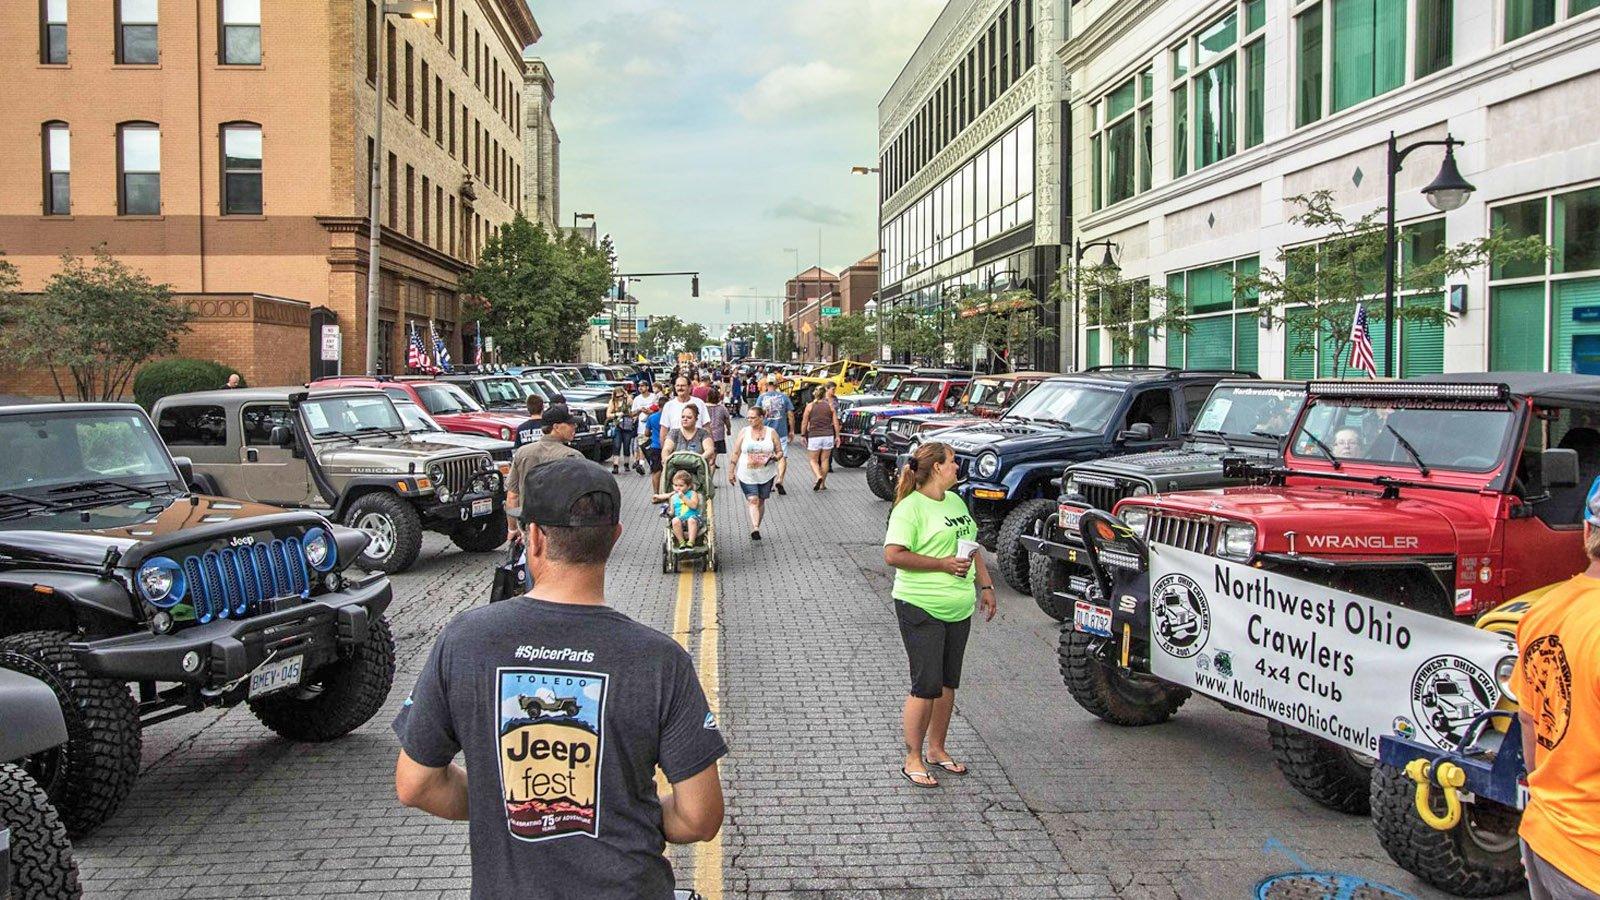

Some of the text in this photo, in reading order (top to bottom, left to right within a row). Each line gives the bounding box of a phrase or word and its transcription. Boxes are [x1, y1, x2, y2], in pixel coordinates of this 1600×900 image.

[230, 536, 254, 547] Jeep
[955, 526, 970, 539] girl
[1305, 535, 1419, 549] WRANGLER
[1214, 564, 1411, 649] Northwest Ohio
[515, 645, 595, 662] #SpicerParts
[1247, 614, 1354, 676] Crawlers
[516, 675, 587, 687] TOLEDO
[1255, 657, 1342, 702] 4x4 Club
[1414, 658, 1448, 701] NORTHWEST
[1453, 659, 1476, 675] OHIO
[507, 731, 591, 769] Jeep
[522, 767, 576, 798] fest
[541, 814, 555, 826] 75
